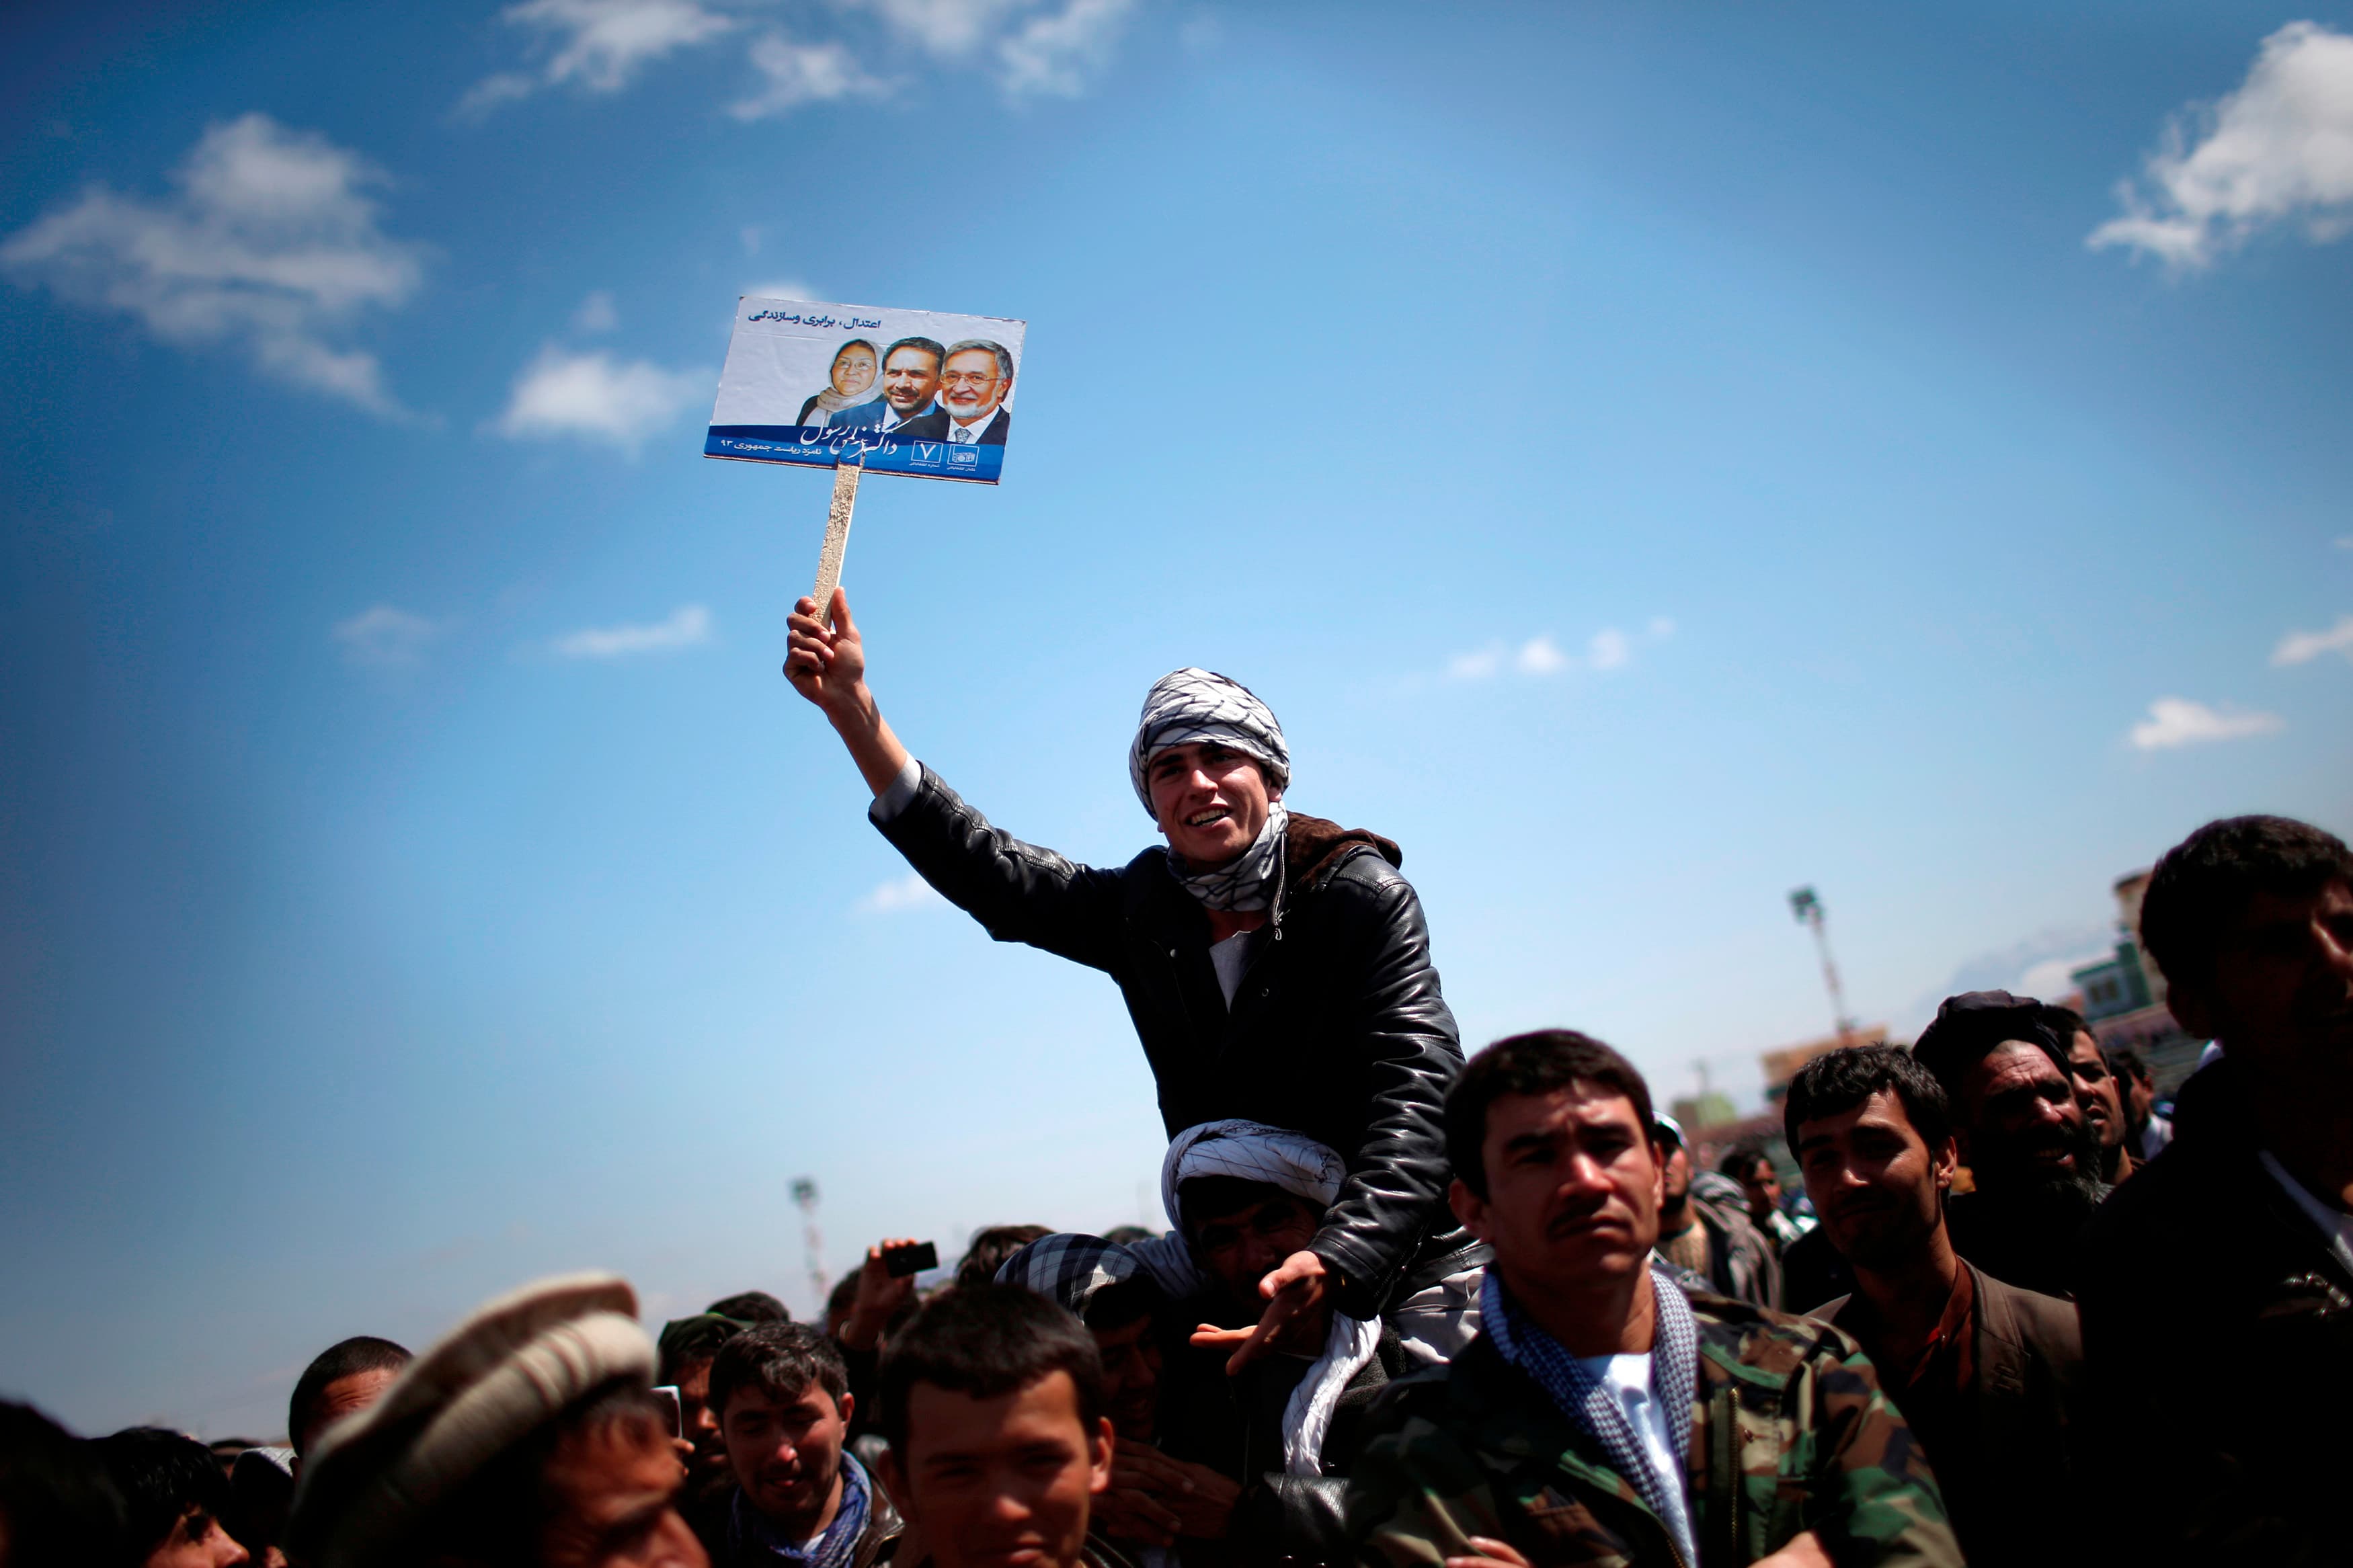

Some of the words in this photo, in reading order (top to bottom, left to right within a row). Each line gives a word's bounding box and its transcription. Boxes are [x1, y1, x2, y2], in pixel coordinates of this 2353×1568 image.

[803, 315, 836, 327] برابری
[733, 442, 772, 452] جمهوری
[774, 446, 801, 454] ریاست
[802, 448, 822, 456] نامزد
